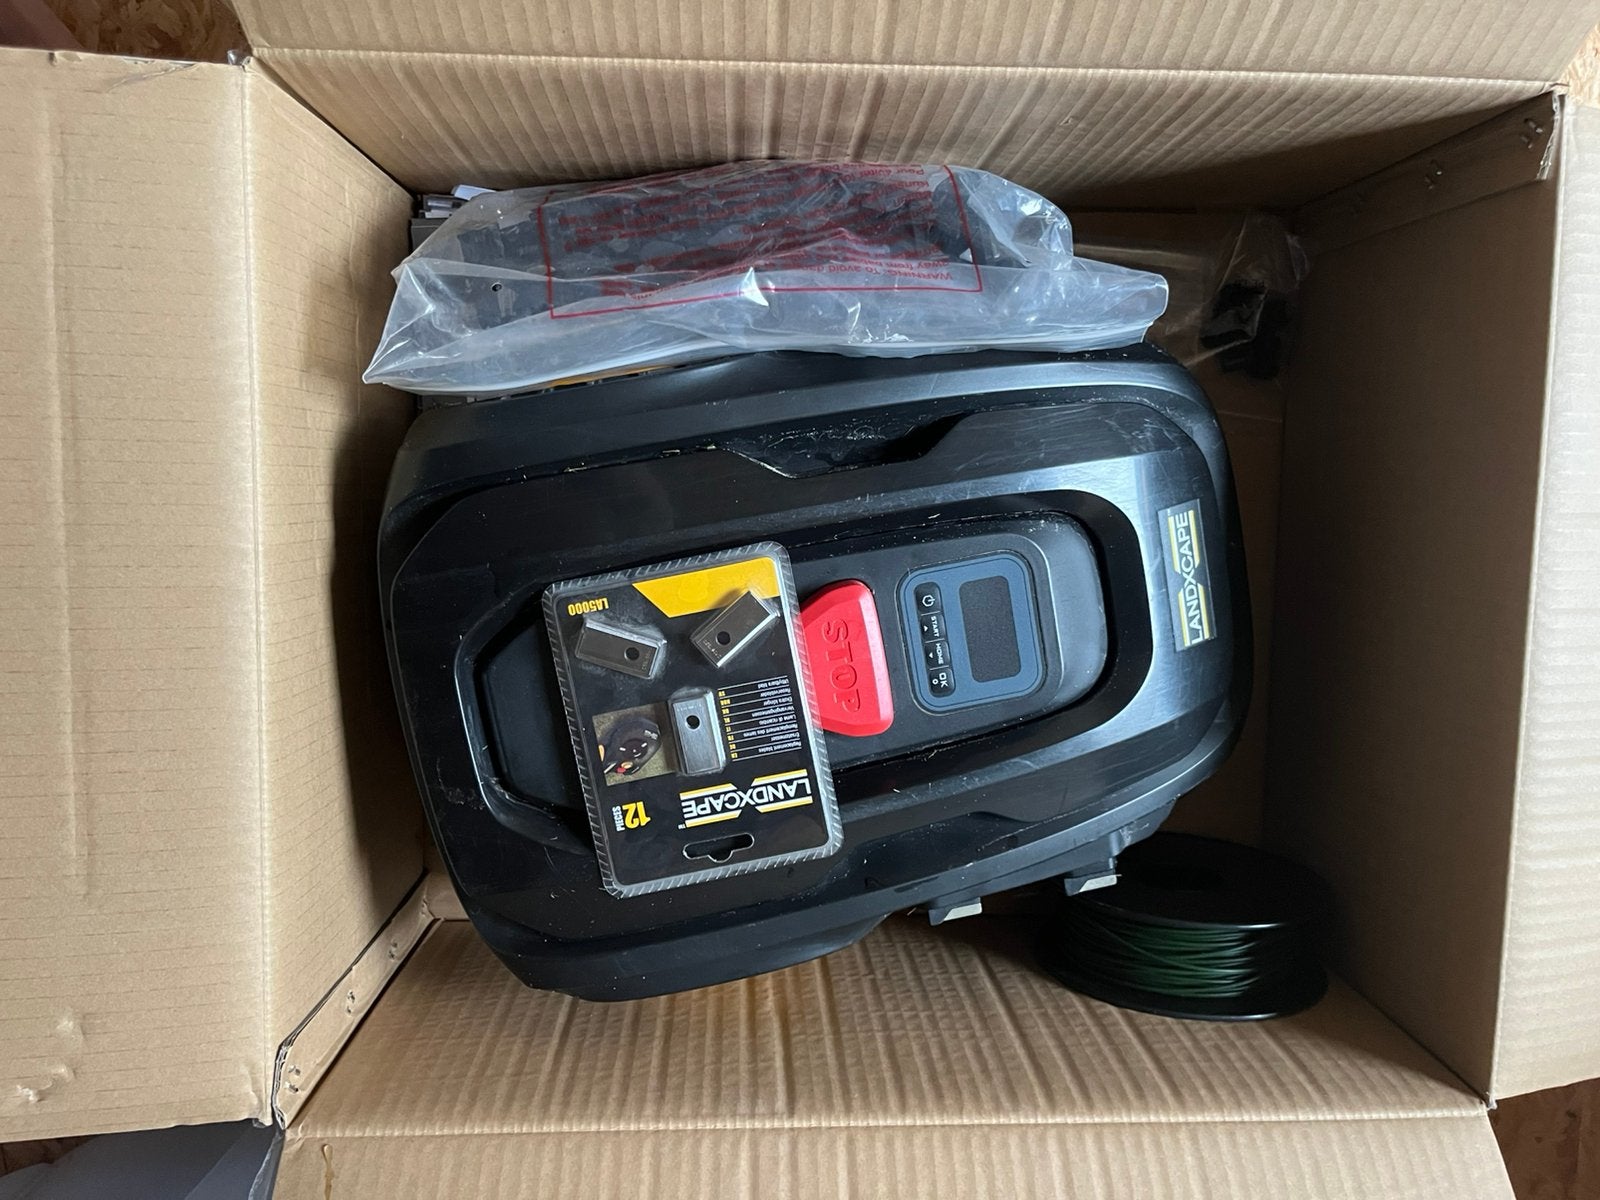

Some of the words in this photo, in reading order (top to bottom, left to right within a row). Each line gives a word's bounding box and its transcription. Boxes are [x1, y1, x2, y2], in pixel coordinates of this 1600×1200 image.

[828, 265, 861, 273] avoid
[865, 266, 880, 275] To
[884, 269, 952, 281] WARNING:
[1175, 511, 1204, 645] LANDXCAPE
[567, 597, 609, 616] LA5000
[930, 615, 940, 637] START
[936, 643, 944, 664] HOME
[821, 619, 861, 712] STOP
[939, 672, 949, 688] OK
[773, 741, 801, 750] Replacement
[681, 777, 812, 819] LANDXCAPE
[612, 805, 625, 831] PIECES
[621, 801, 651, 829] 12
